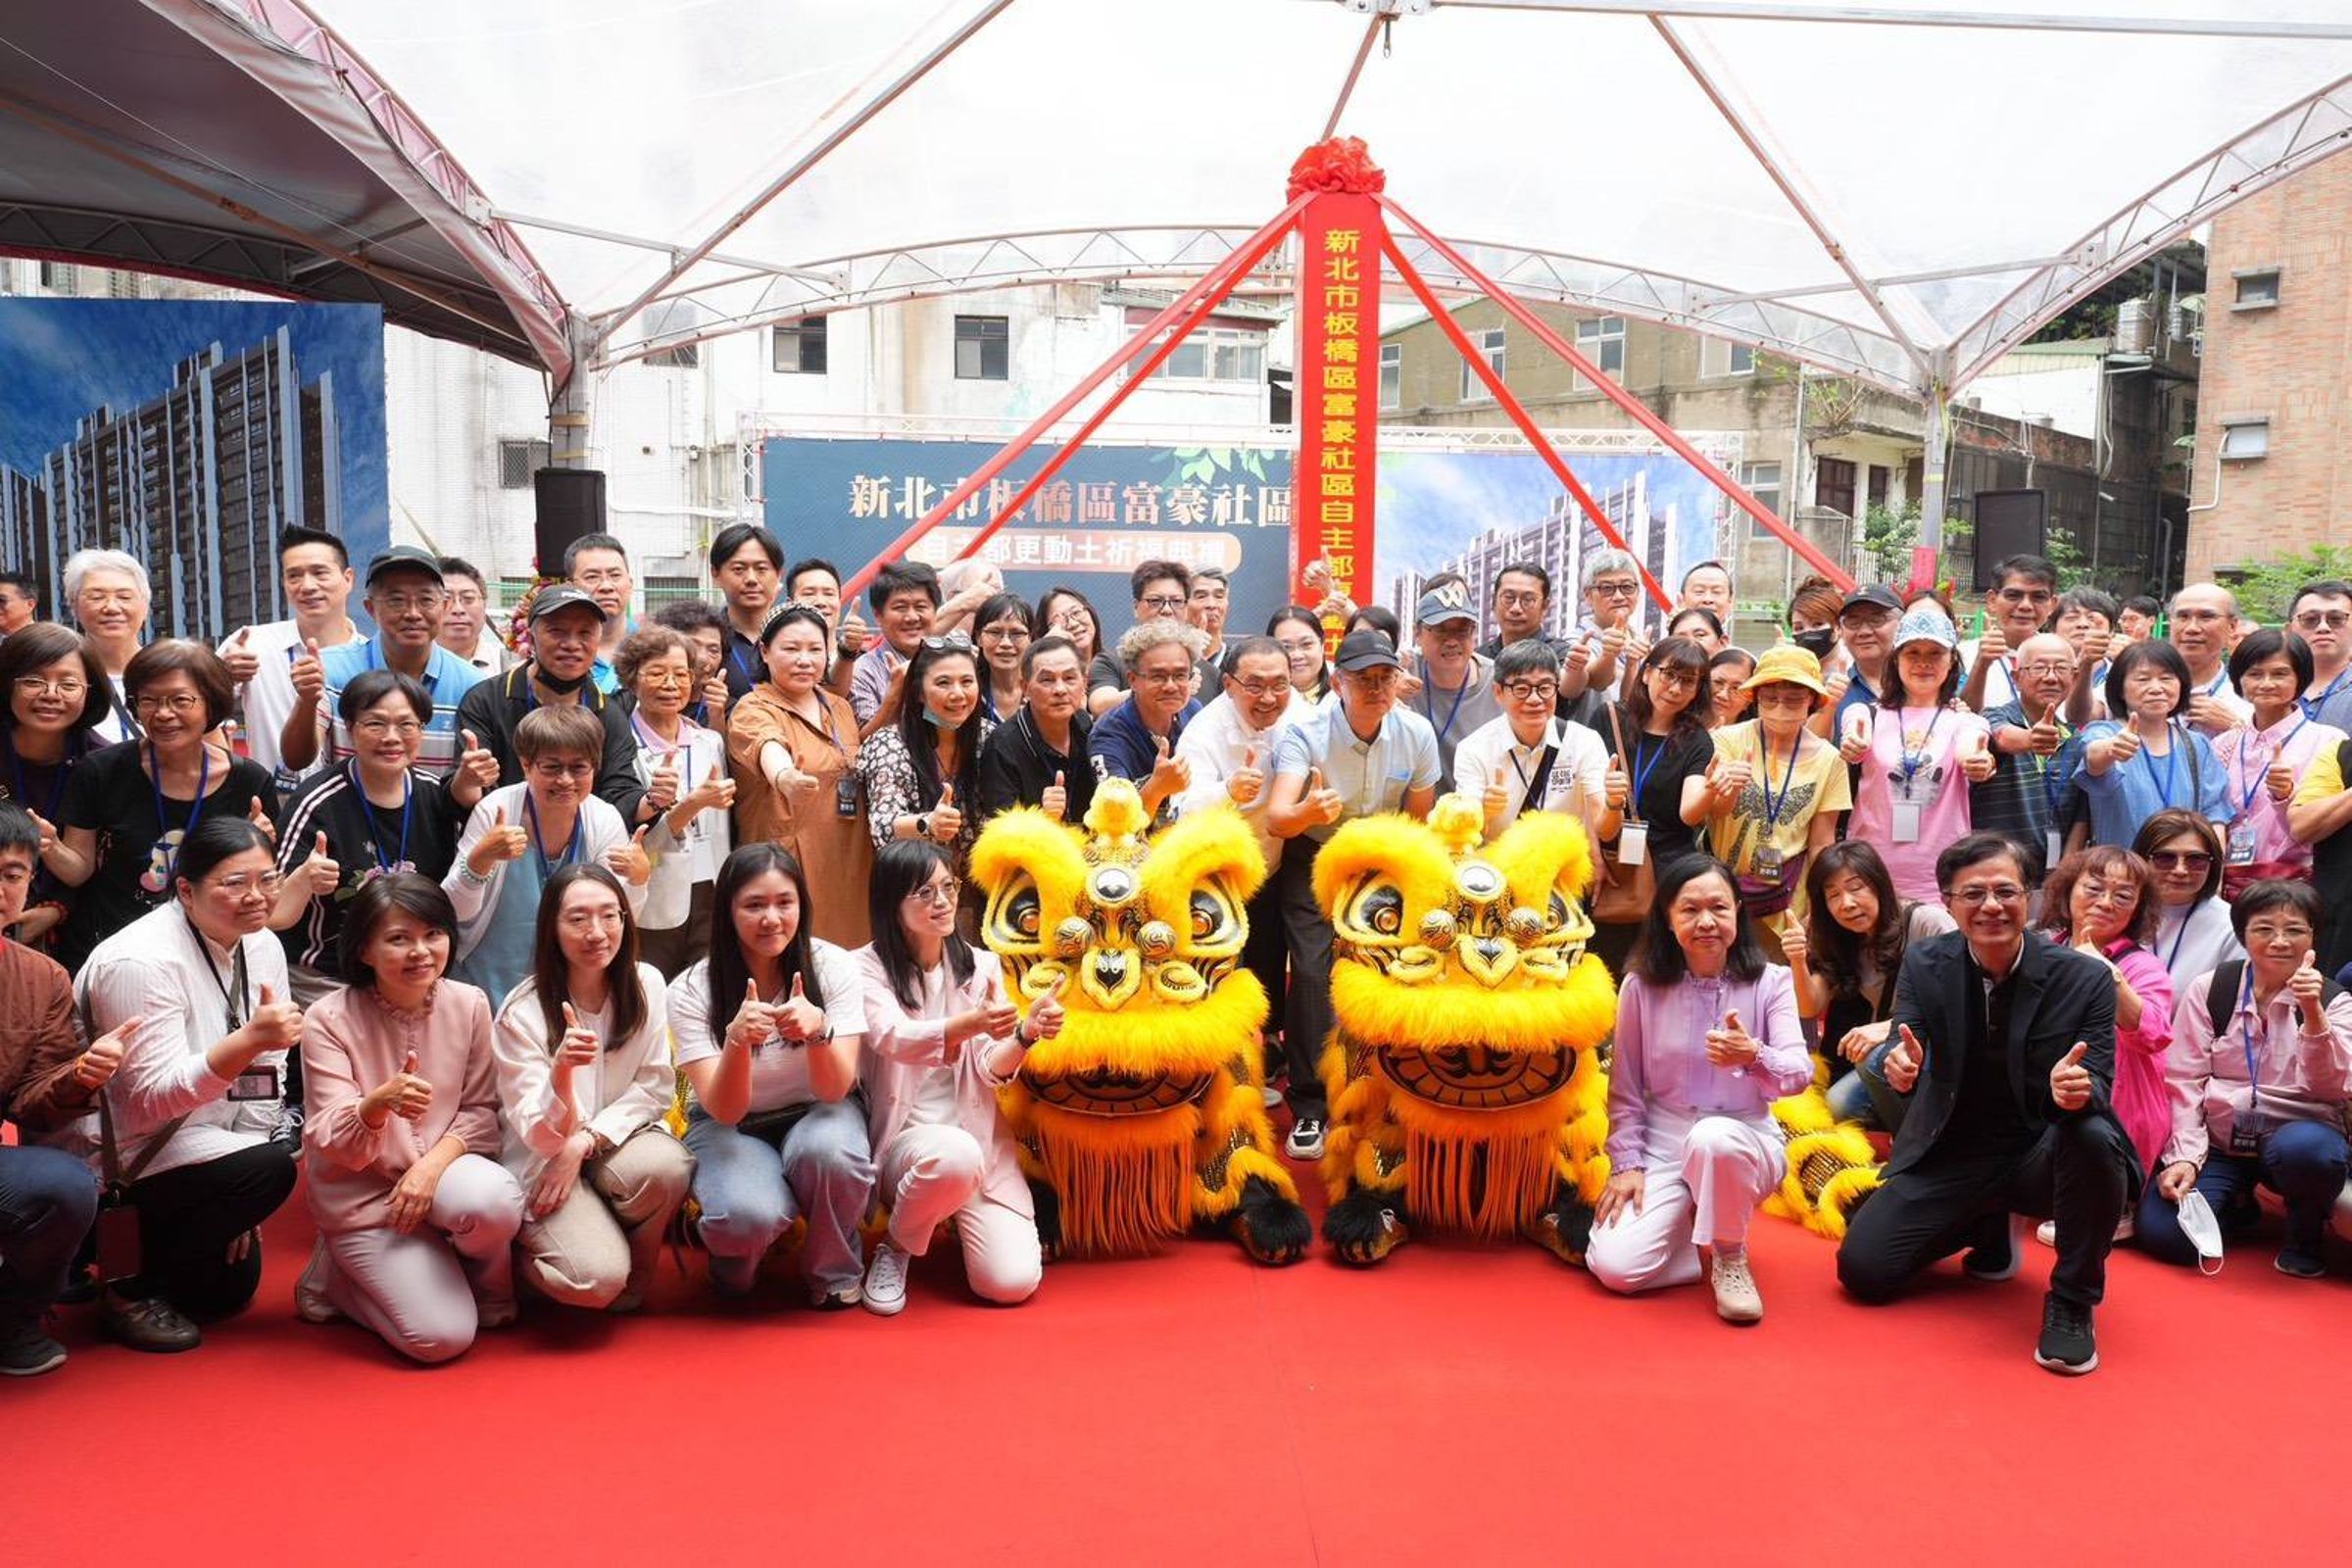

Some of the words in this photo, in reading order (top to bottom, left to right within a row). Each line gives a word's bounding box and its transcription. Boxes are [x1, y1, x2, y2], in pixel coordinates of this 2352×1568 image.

[1320, 229, 1360, 657] 新北市板橋區富豪社區自主都土
[848, 475, 1291, 526] 新北市板橋區富豪社區
[1434, 586, 1465, 608] W
